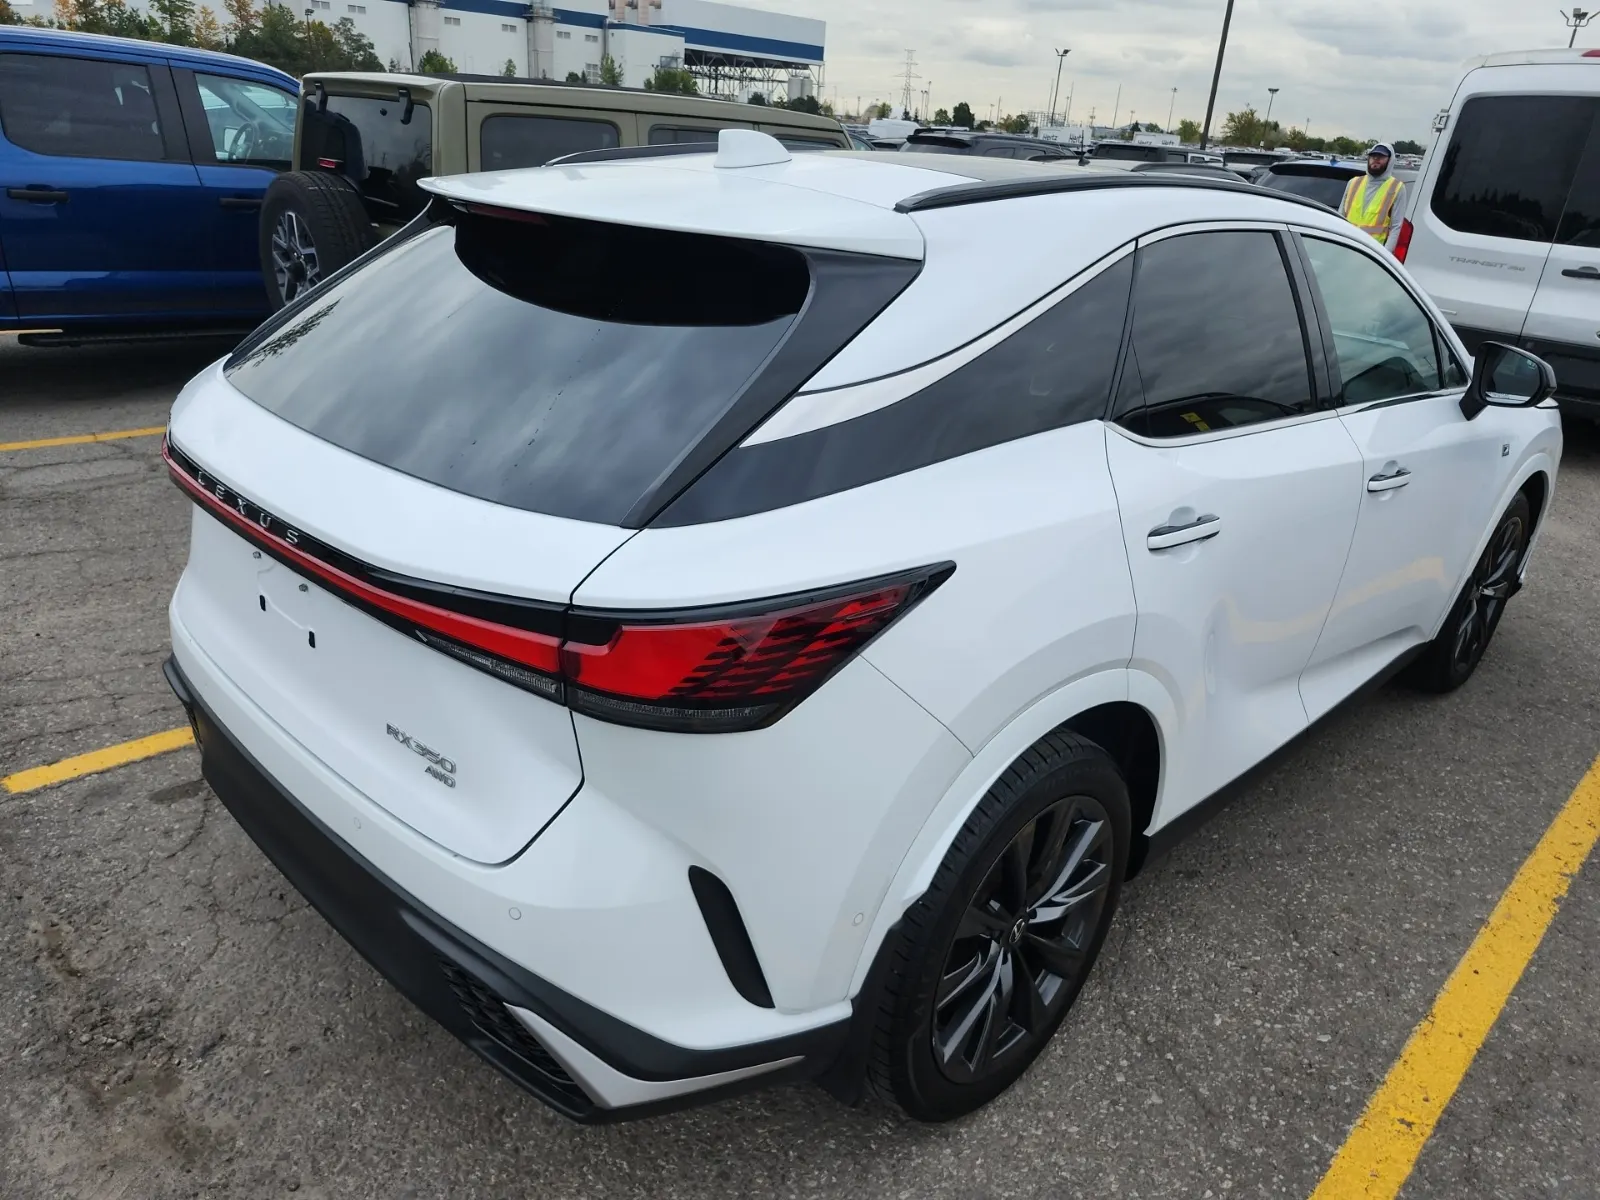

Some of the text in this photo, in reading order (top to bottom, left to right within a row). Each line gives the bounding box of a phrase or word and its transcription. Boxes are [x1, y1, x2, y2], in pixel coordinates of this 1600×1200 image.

[1449, 256, 1507, 268] TRANSIT
[198, 471, 299, 545] LEXUS
[424, 764, 456, 788] AWD
